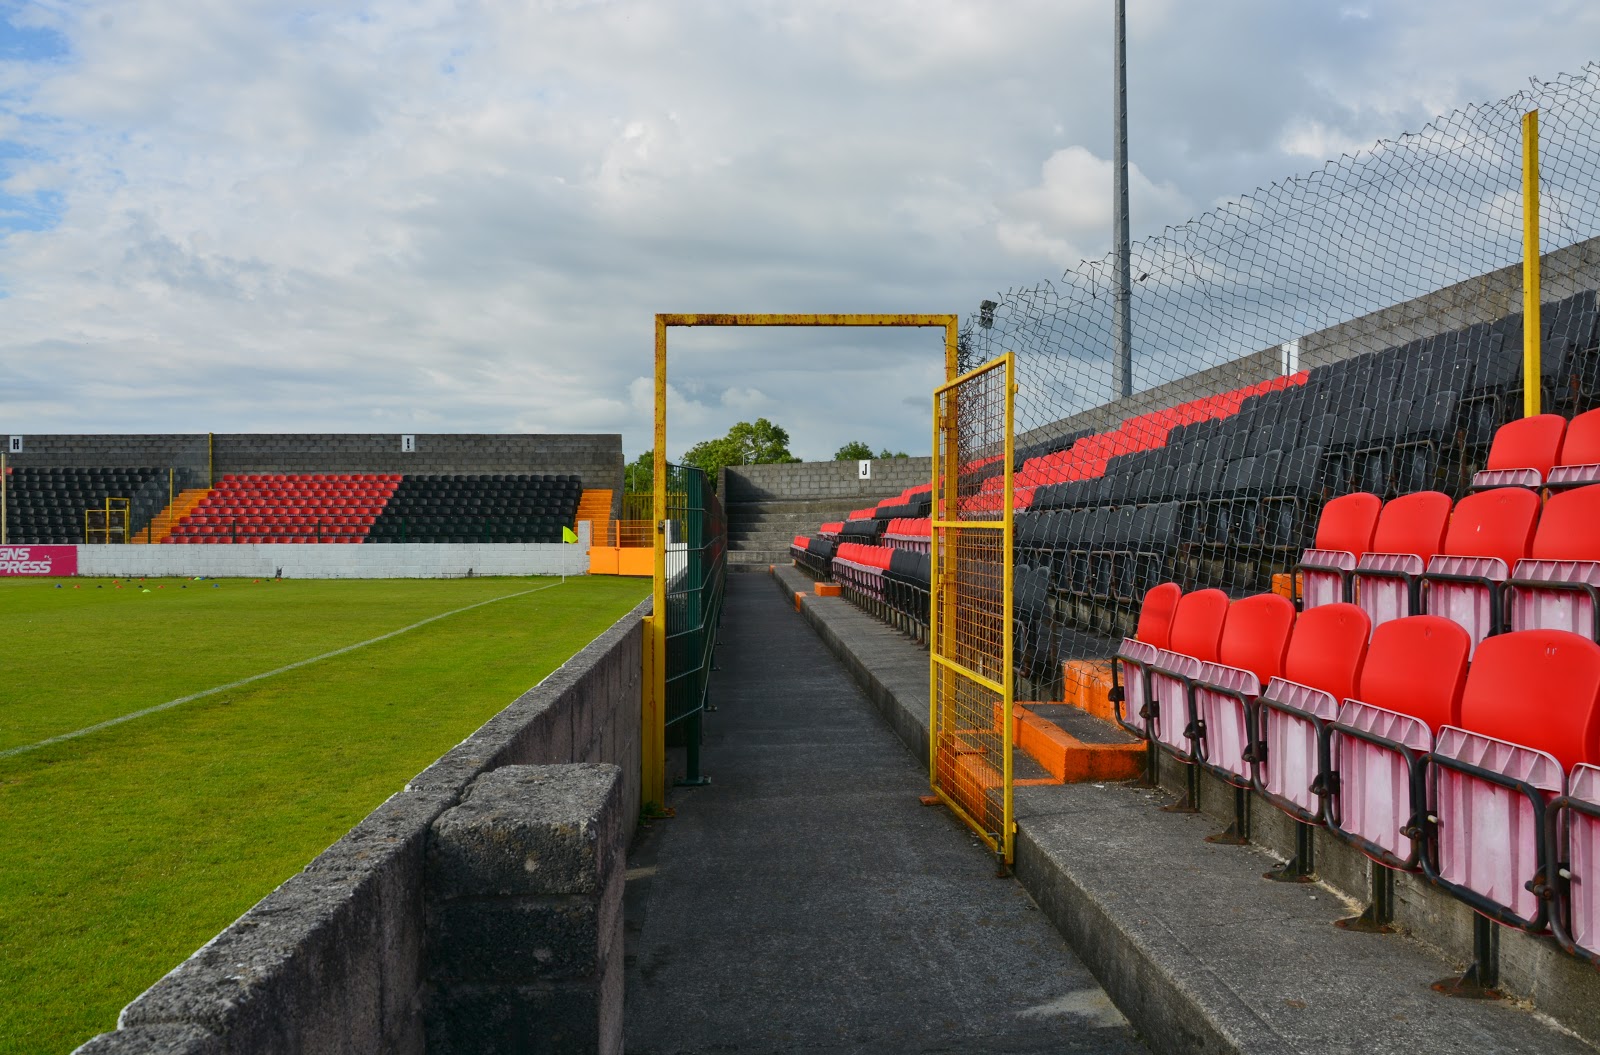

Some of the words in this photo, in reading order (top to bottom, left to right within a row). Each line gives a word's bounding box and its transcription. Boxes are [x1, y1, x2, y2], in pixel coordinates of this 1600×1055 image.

[13, 438, 20, 450] H
[862, 463, 868, 476] J
[0, 560, 52, 575] PRESS
